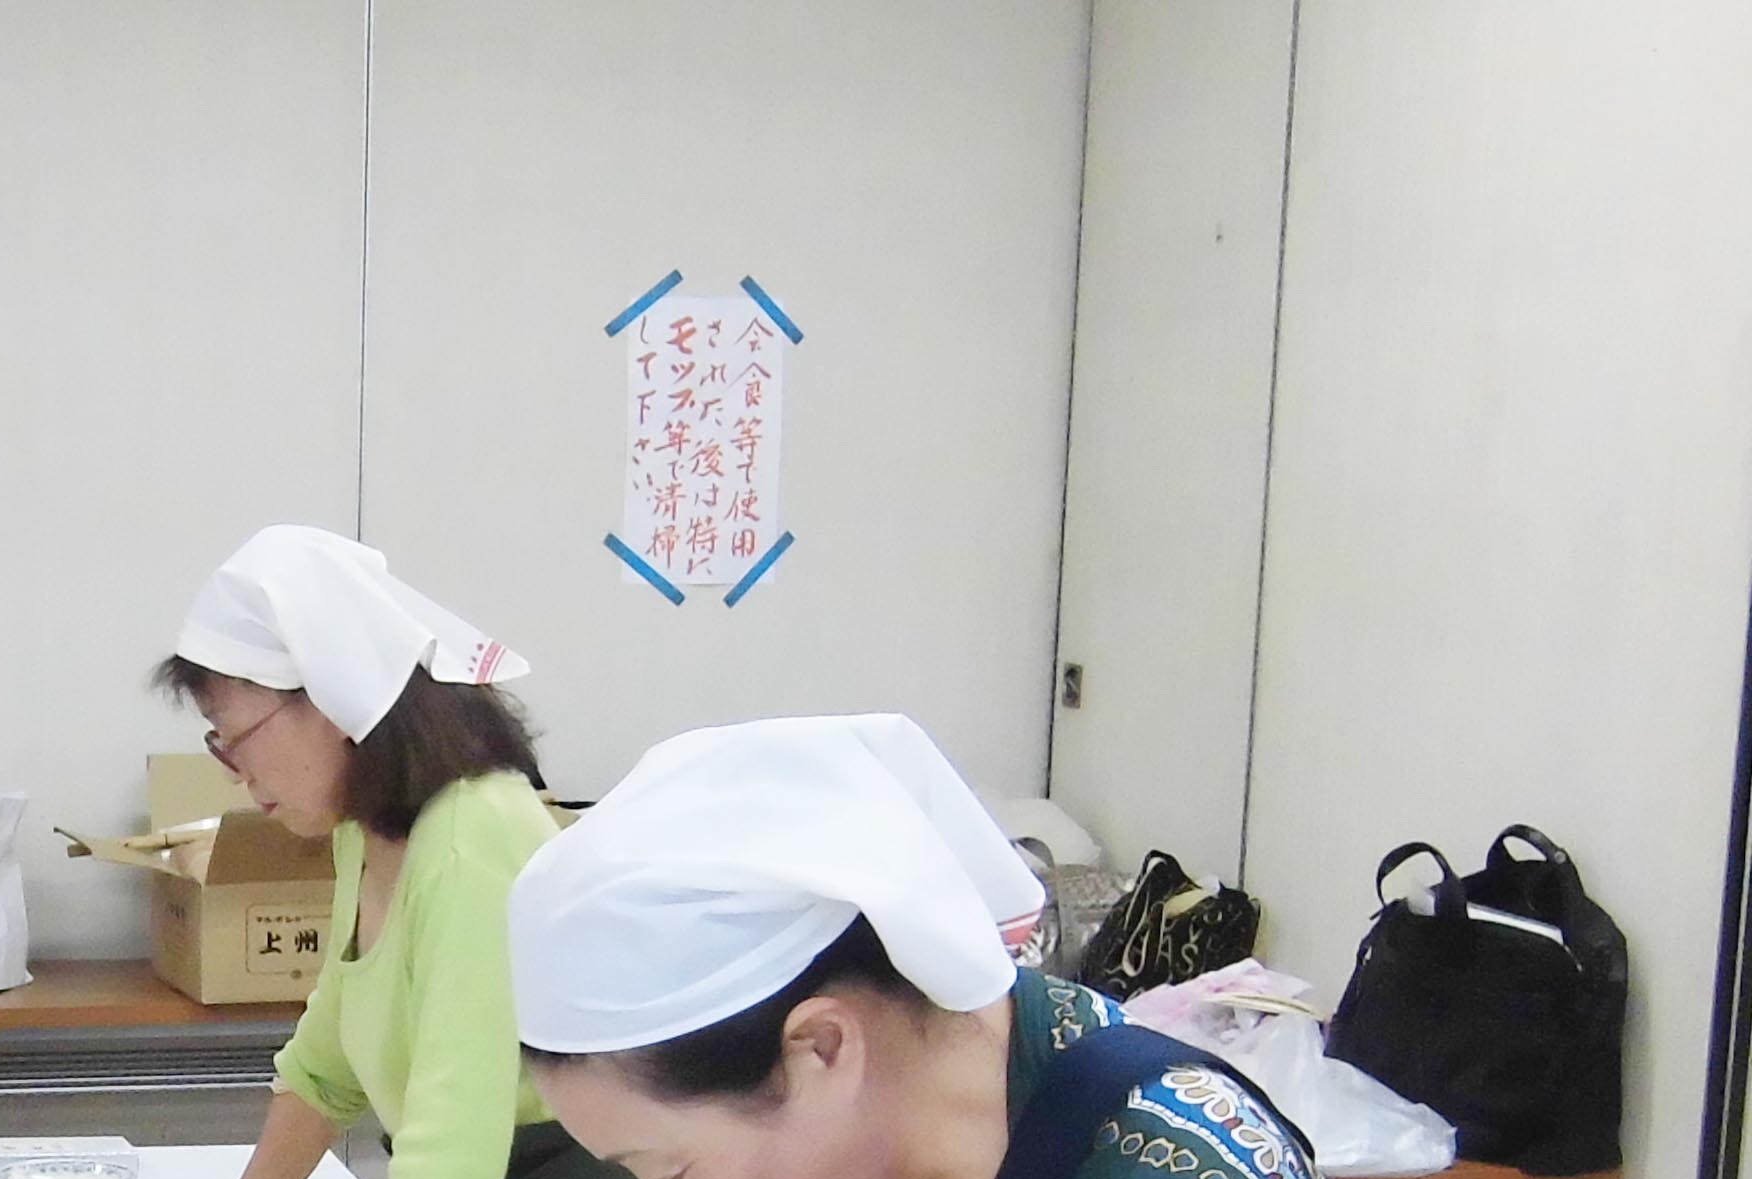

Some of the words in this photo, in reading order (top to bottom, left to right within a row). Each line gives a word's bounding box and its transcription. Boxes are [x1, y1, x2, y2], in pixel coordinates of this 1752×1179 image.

[632, 315, 657, 490] して下さい
[684, 319, 728, 576] された後は特に
[259, 928, 319, 955] 上州
